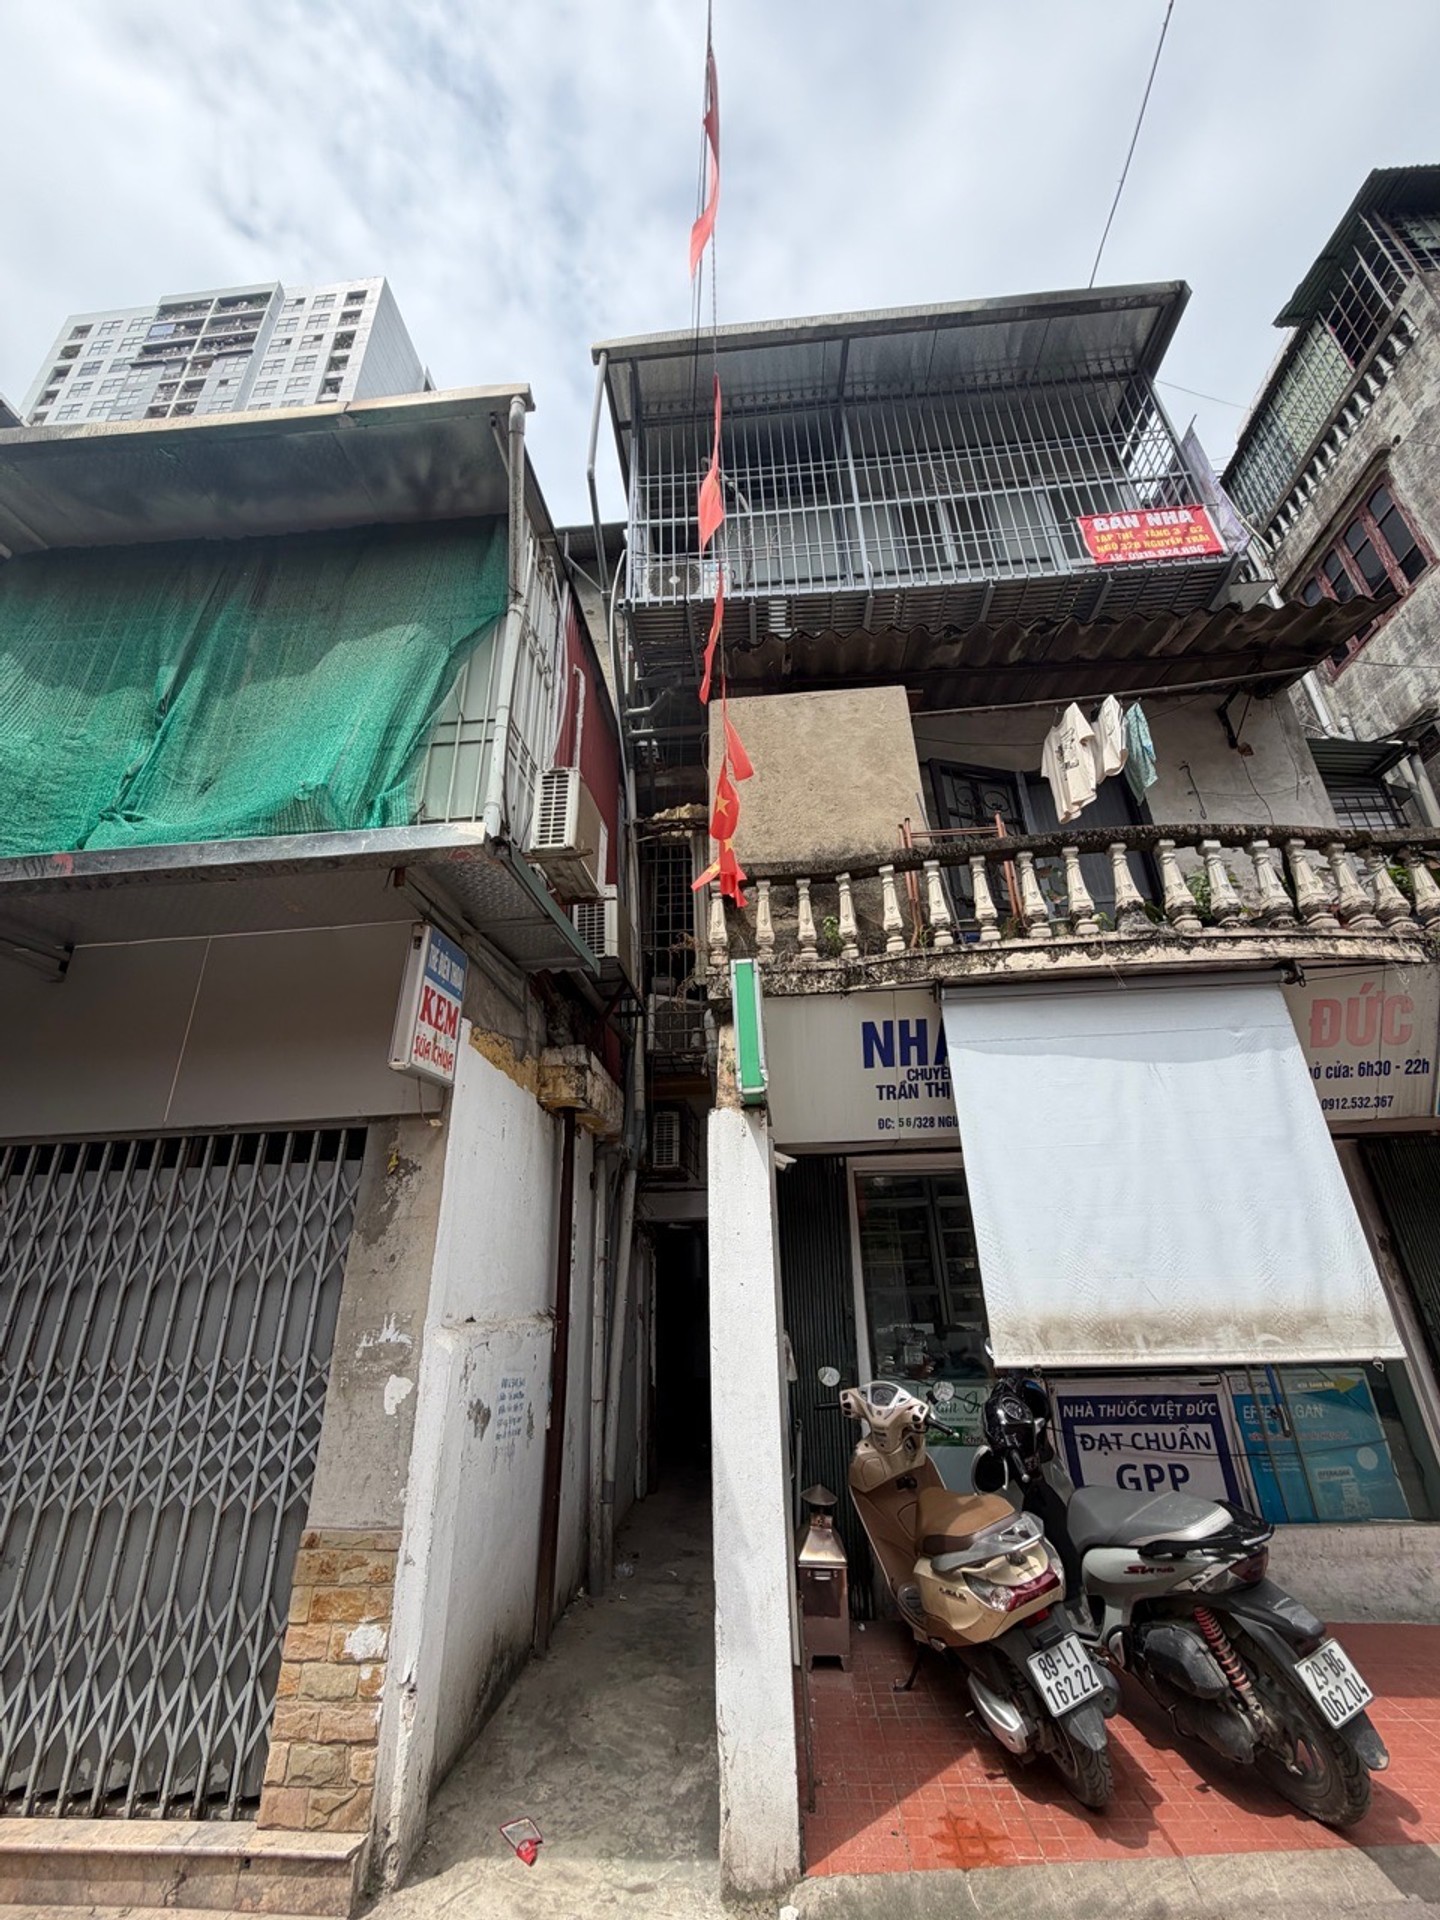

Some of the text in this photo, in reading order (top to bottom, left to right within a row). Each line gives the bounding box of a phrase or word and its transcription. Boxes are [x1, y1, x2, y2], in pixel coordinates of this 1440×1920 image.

[419, 985, 460, 1040] KEM
[1309, 982, 1415, 1049] ĐỨC
[1358, 1060, 1391, 1077] 6h30
[1404, 1058, 1430, 1075] 22h
[876, 1081, 951, 1100] TRẦN THỊ
[1321, 1095, 1394, 1111] 0912.532.367
[1063, 1400, 1217, 1420] NHÀ THUỐC VIỆT ĐỨC
[1079, 1424, 1212, 1456] ĐẠT CHUẨN
[1115, 1463, 1190, 1492] GPP
[1038, 1641, 1081, 1680] 89-L1
[1046, 1663, 1099, 1710] 162.22
[1321, 1673, 1370, 1722] 062.04
